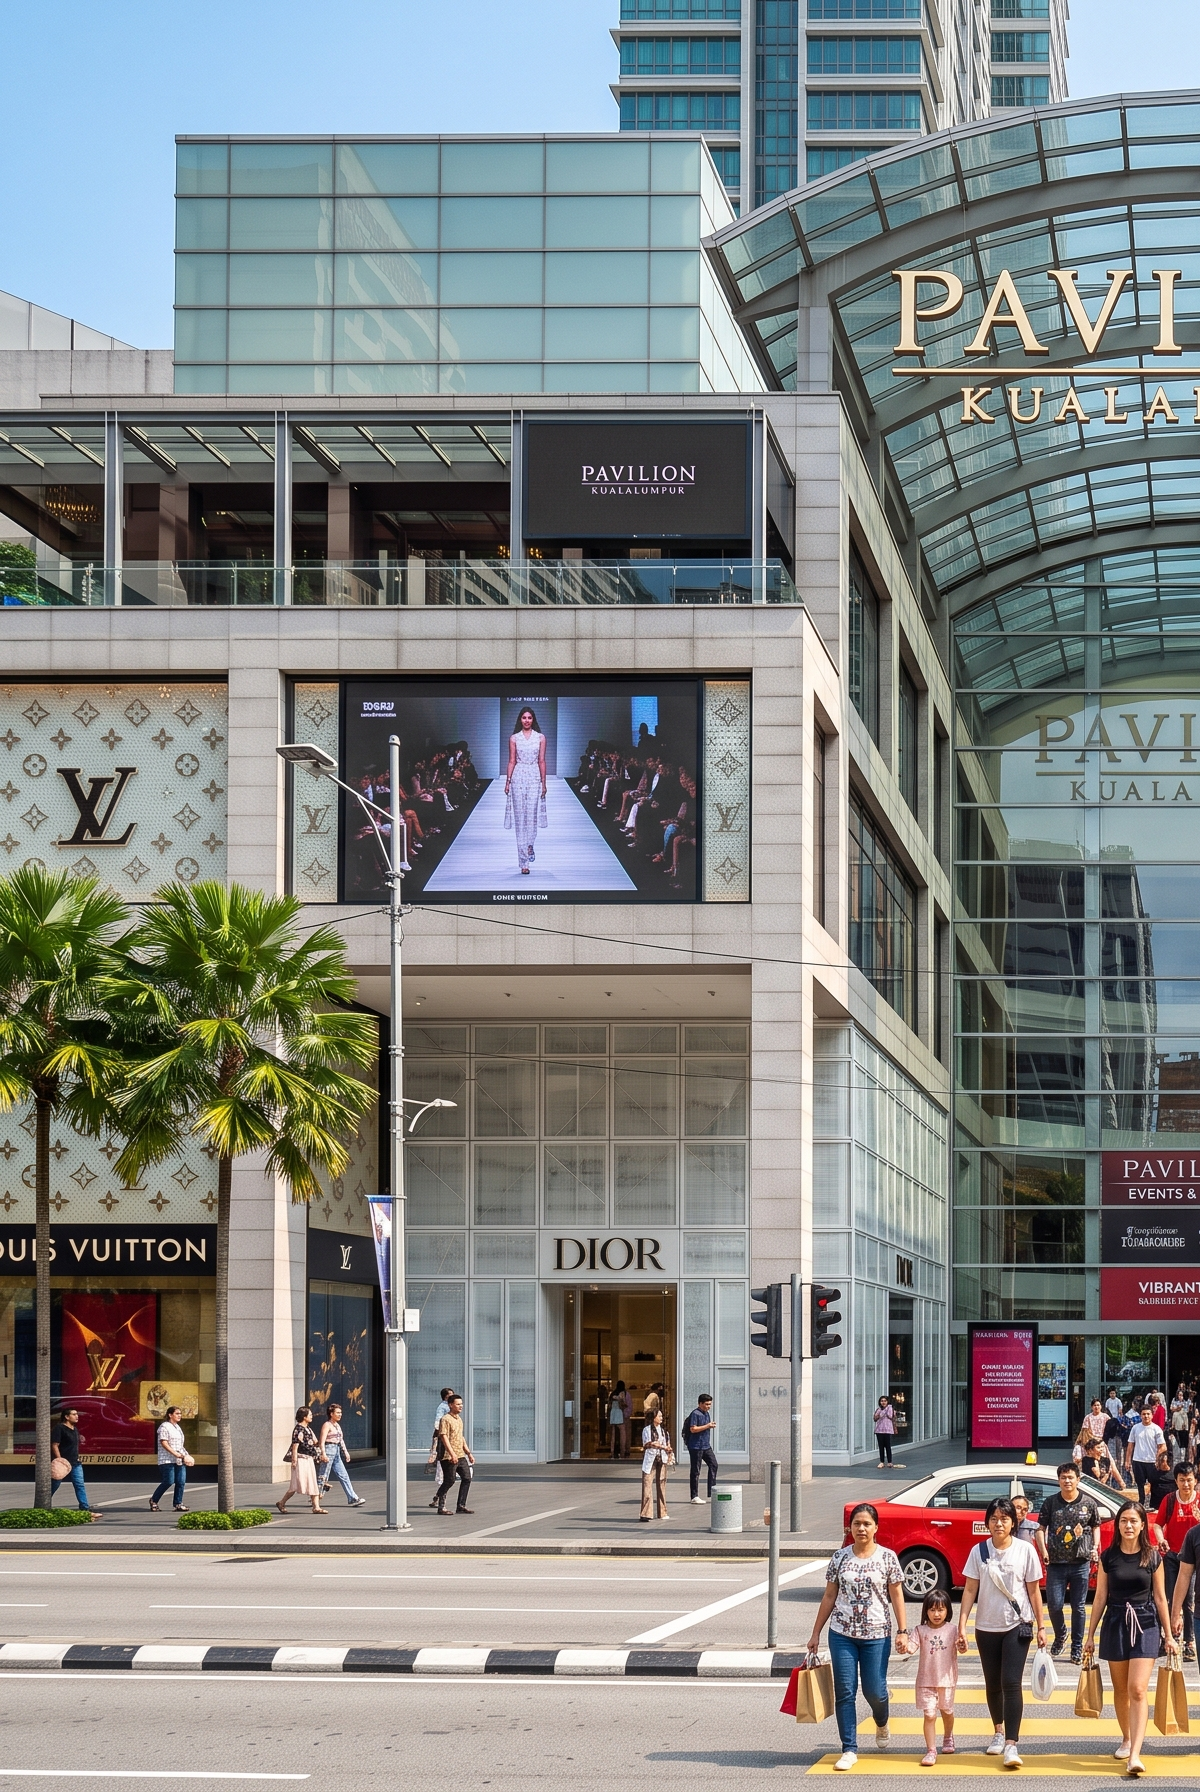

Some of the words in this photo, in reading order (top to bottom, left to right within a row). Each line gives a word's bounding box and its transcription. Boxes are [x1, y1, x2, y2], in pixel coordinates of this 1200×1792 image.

[581, 465, 696, 481] PAVILION
[1128, 1188, 1184, 1200] EVENTS
[1187, 1188, 1197, 1199] &
[69, 1238, 207, 1263] VUITTON
[553, 1237, 667, 1271] DIOR
